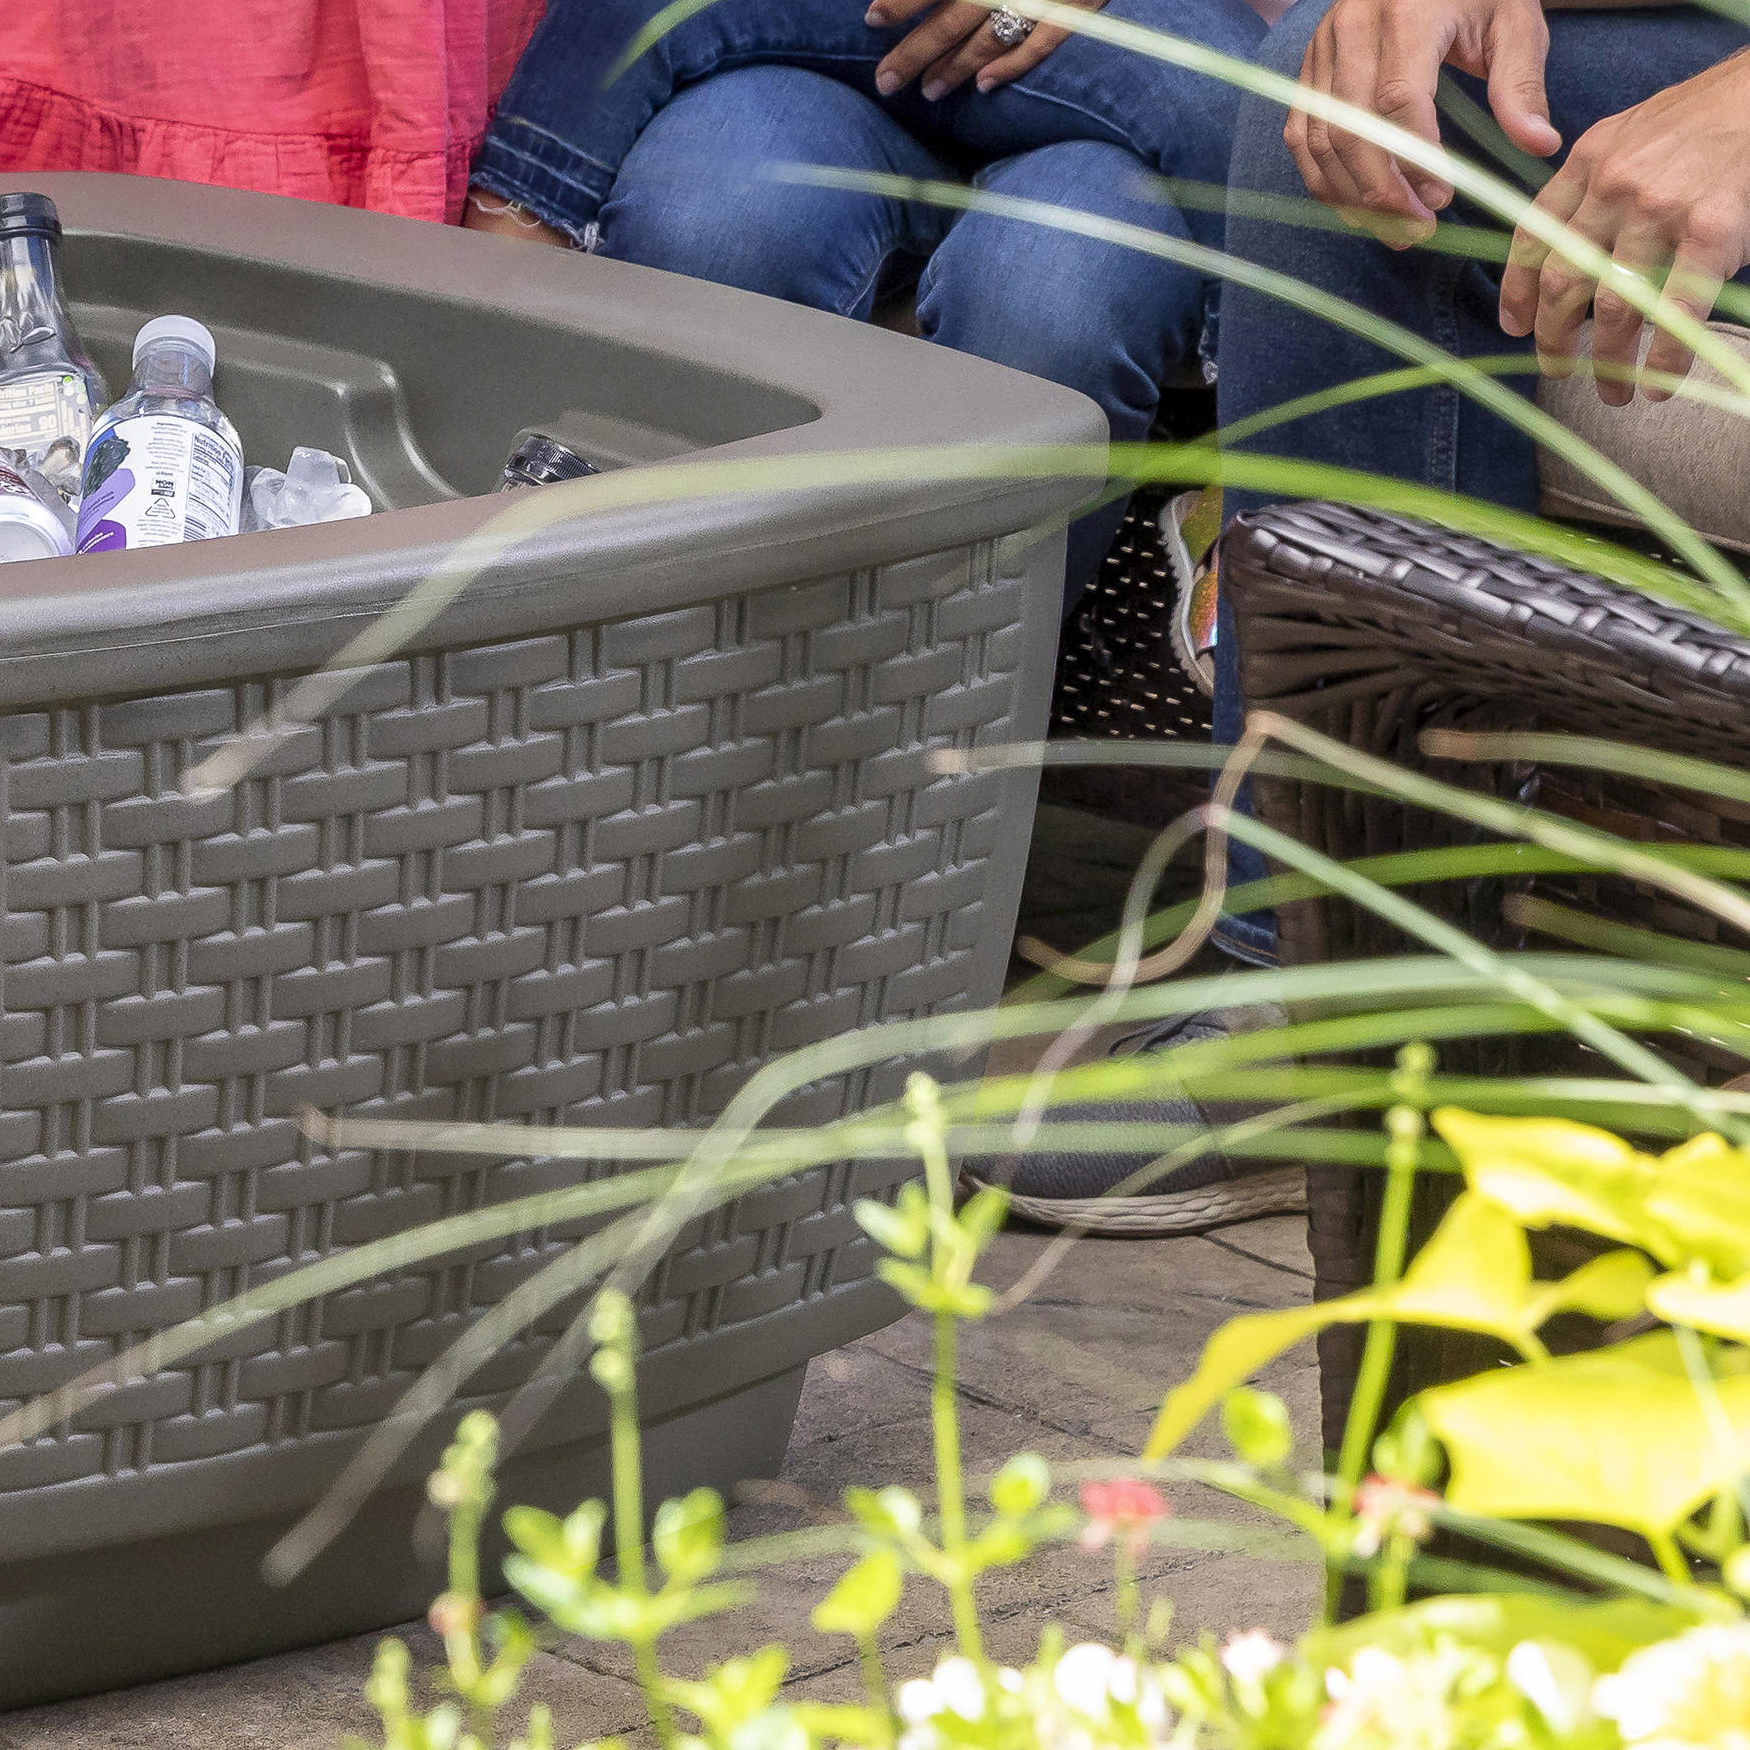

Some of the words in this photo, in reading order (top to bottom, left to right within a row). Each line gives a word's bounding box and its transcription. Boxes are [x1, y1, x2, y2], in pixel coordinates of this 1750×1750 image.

[28, 382, 54, 396] Facts
[39, 414, 58, 430] 90
[194, 435, 222, 457] Nutrition
